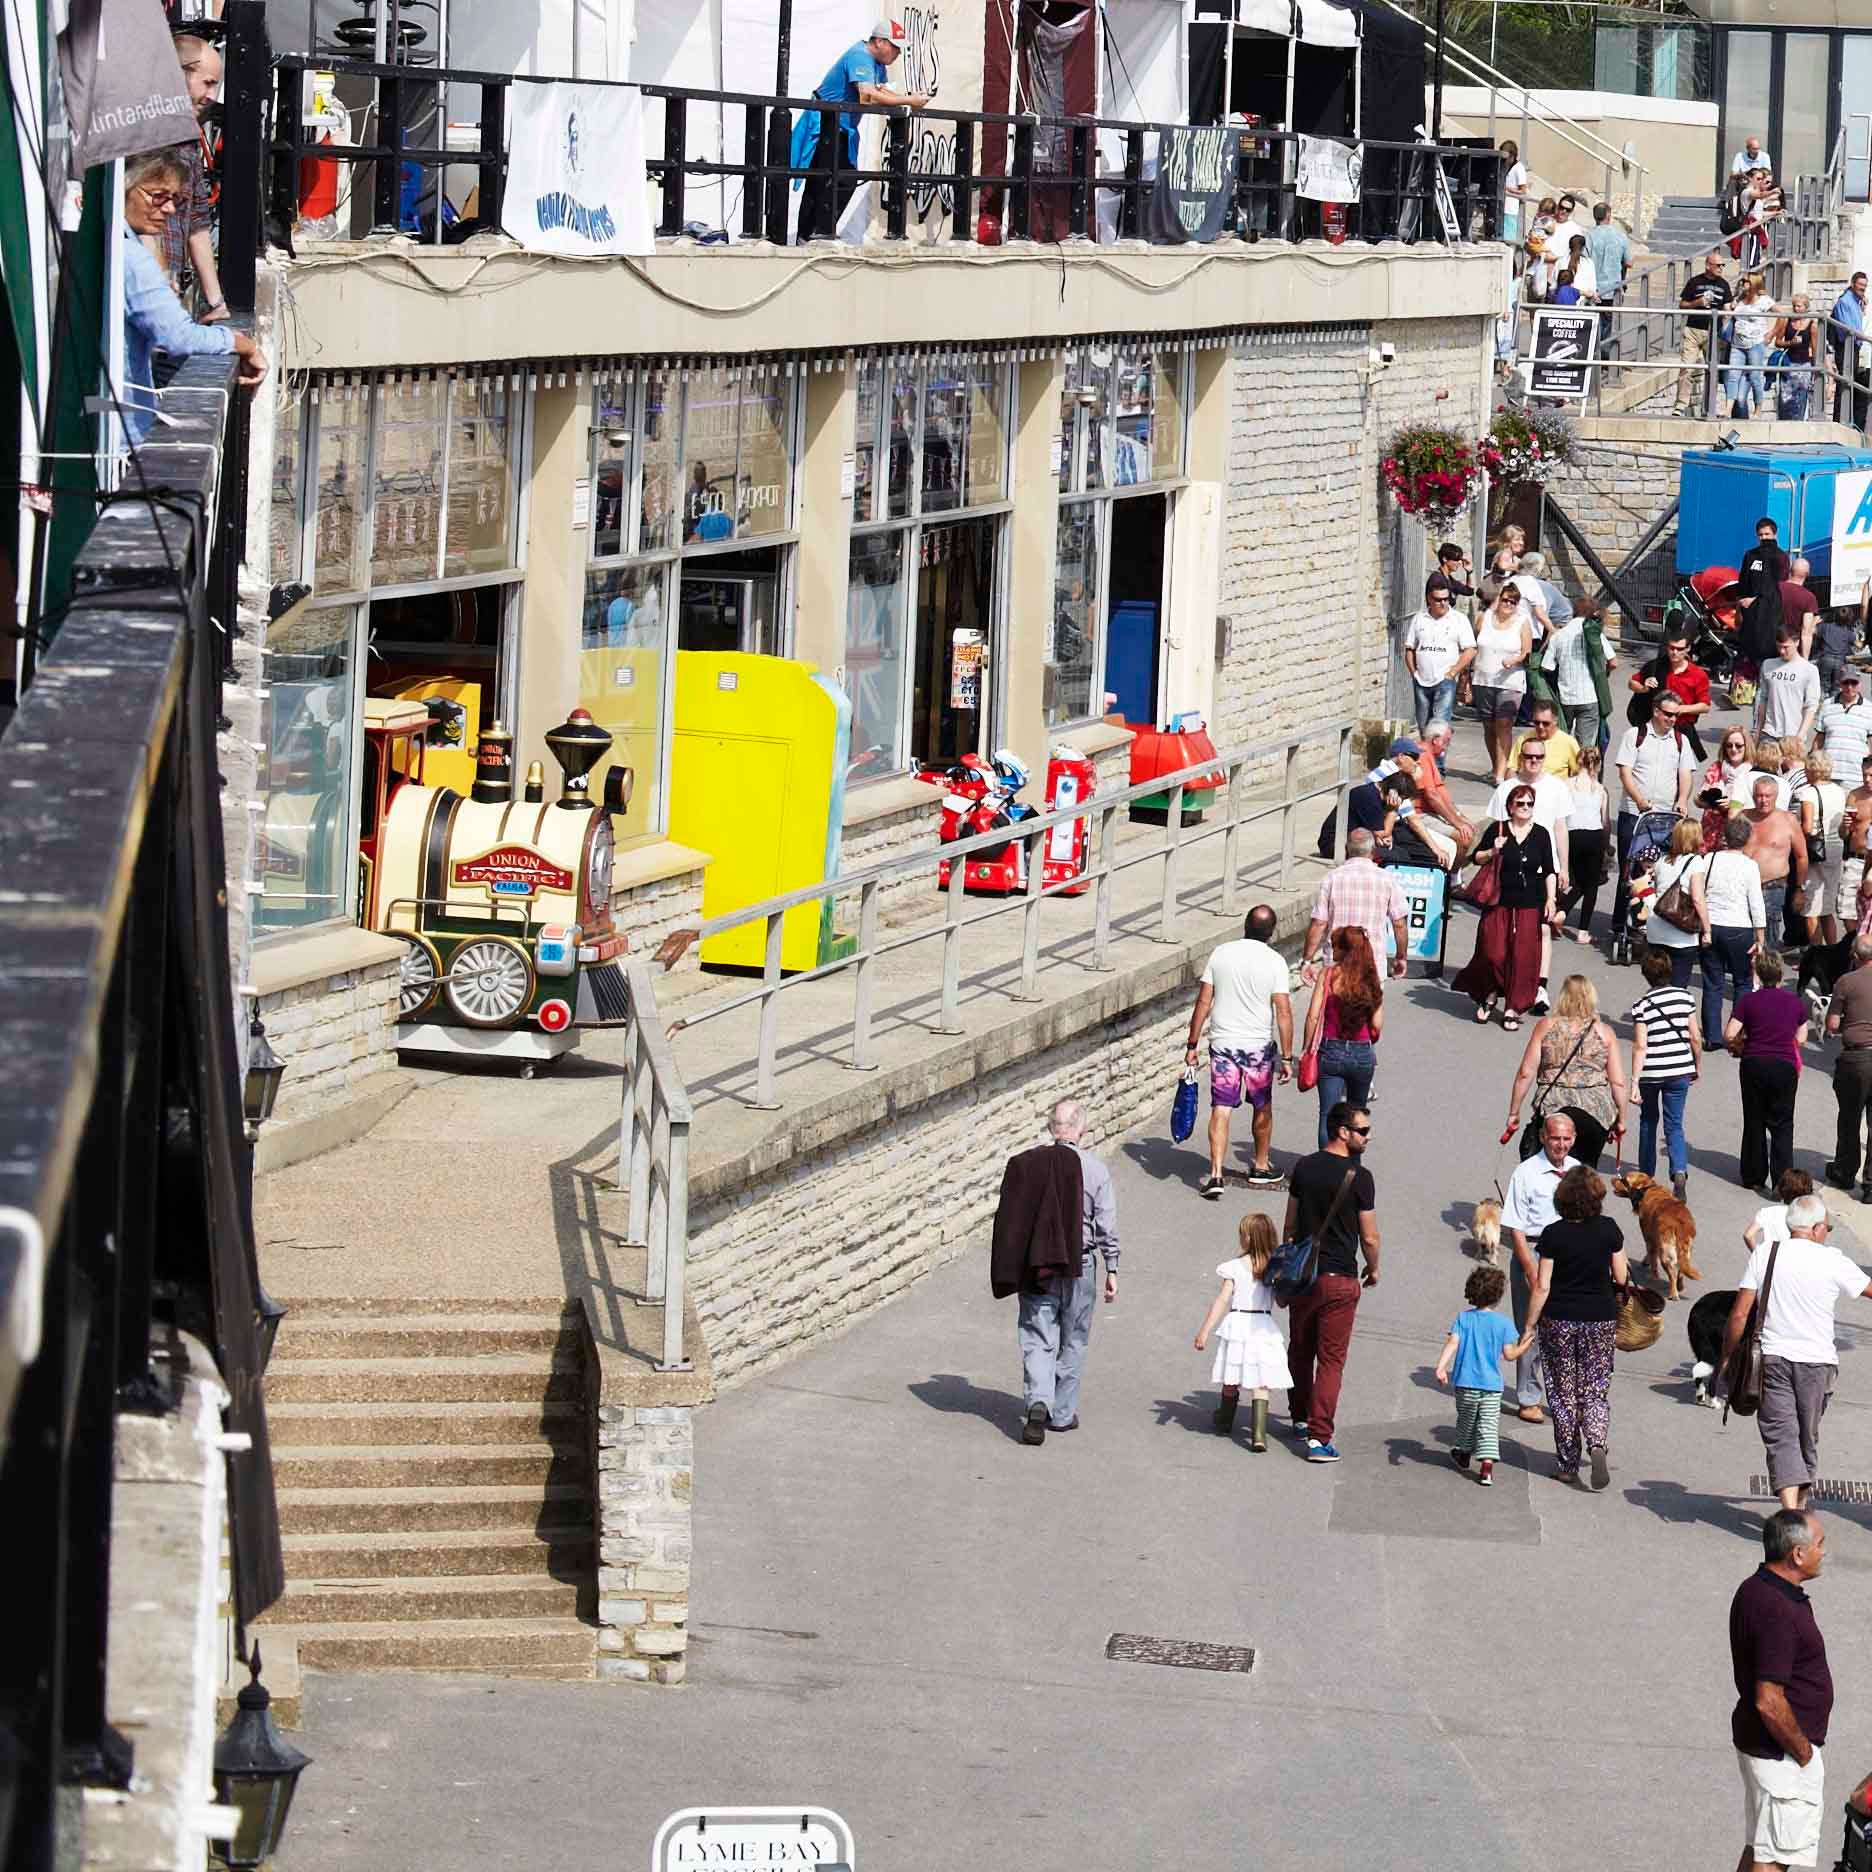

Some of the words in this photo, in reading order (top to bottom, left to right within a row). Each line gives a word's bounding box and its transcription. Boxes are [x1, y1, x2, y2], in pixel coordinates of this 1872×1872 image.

[1547, 318, 1585, 328] SPECIALITY
[1552, 329, 1577, 338] COFFEE
[1771, 671, 1796, 682] POLO
[489, 854, 540, 871] UNION
[470, 870, 556, 885] PACIFIC
[678, 1841, 757, 1861] LYME
[768, 1840, 829, 1860] BAY
